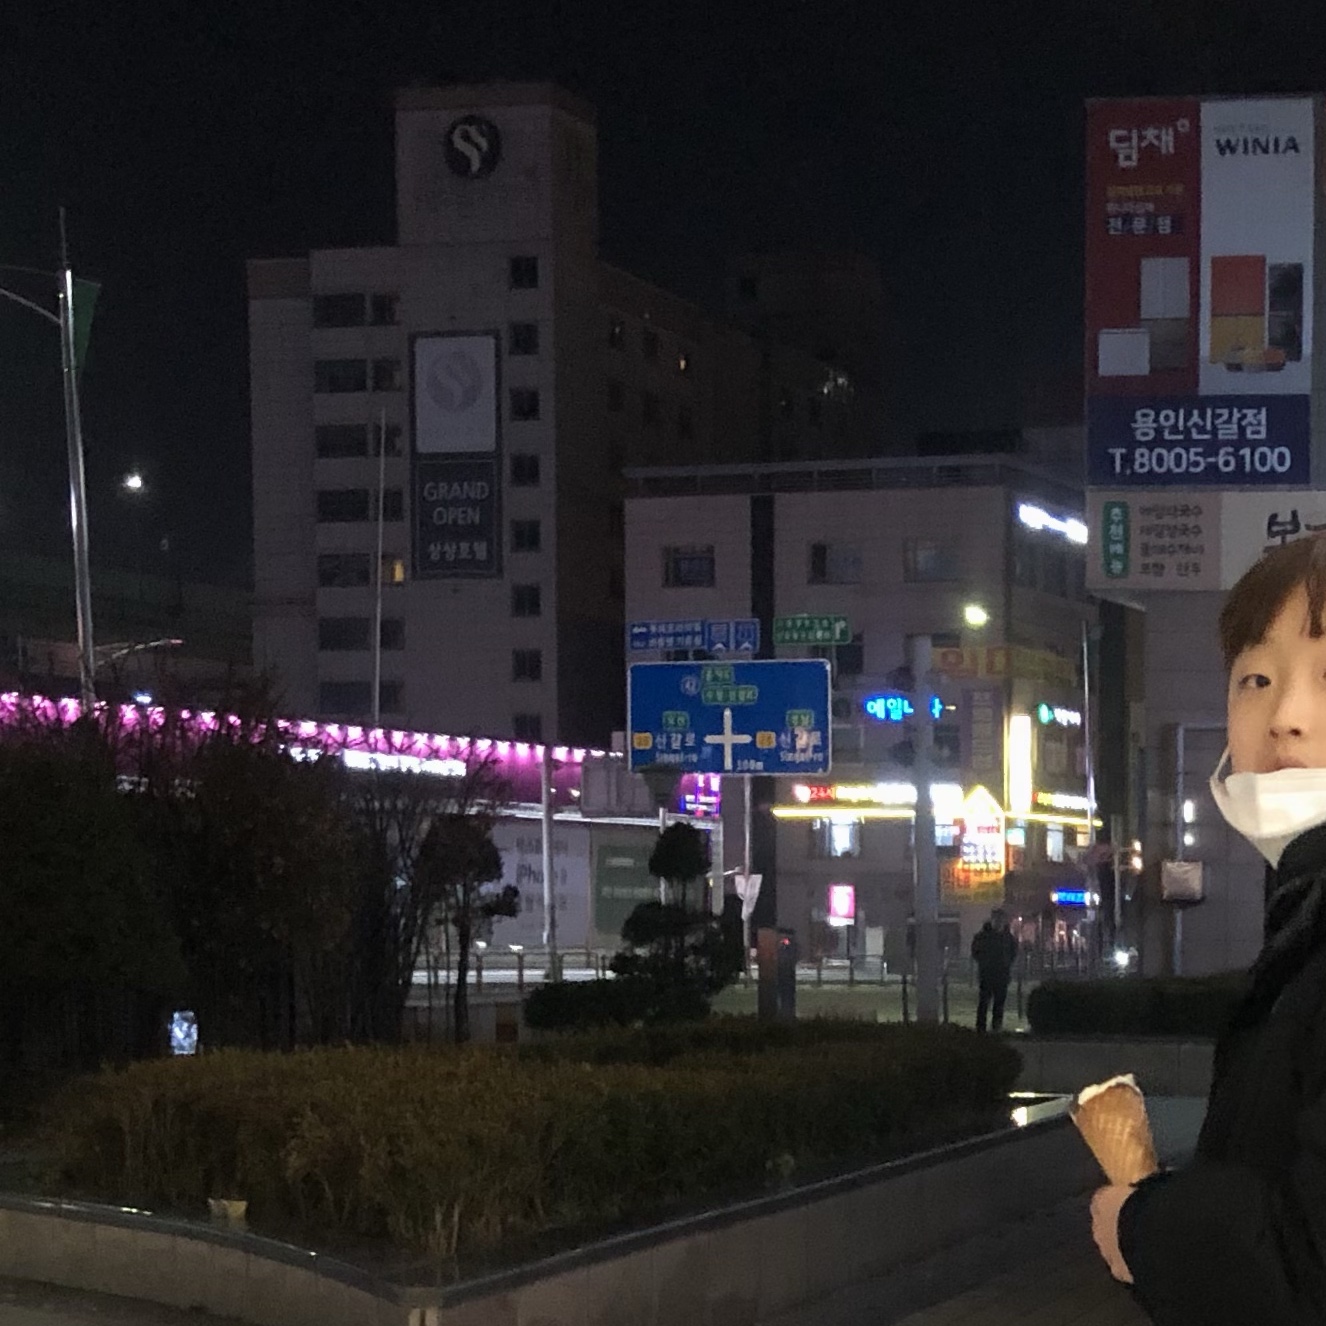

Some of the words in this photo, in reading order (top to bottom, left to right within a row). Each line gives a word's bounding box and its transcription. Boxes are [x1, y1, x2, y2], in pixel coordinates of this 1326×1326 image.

[1109, 125, 1174, 168] 딤채
[1216, 135, 1300, 156] WINIA
[1131, 407, 1268, 441] 용인신갈점
[424, 481, 489, 502] GRAND
[433, 507, 480, 525] OPEN
[656, 732, 696, 749] 신갈로
